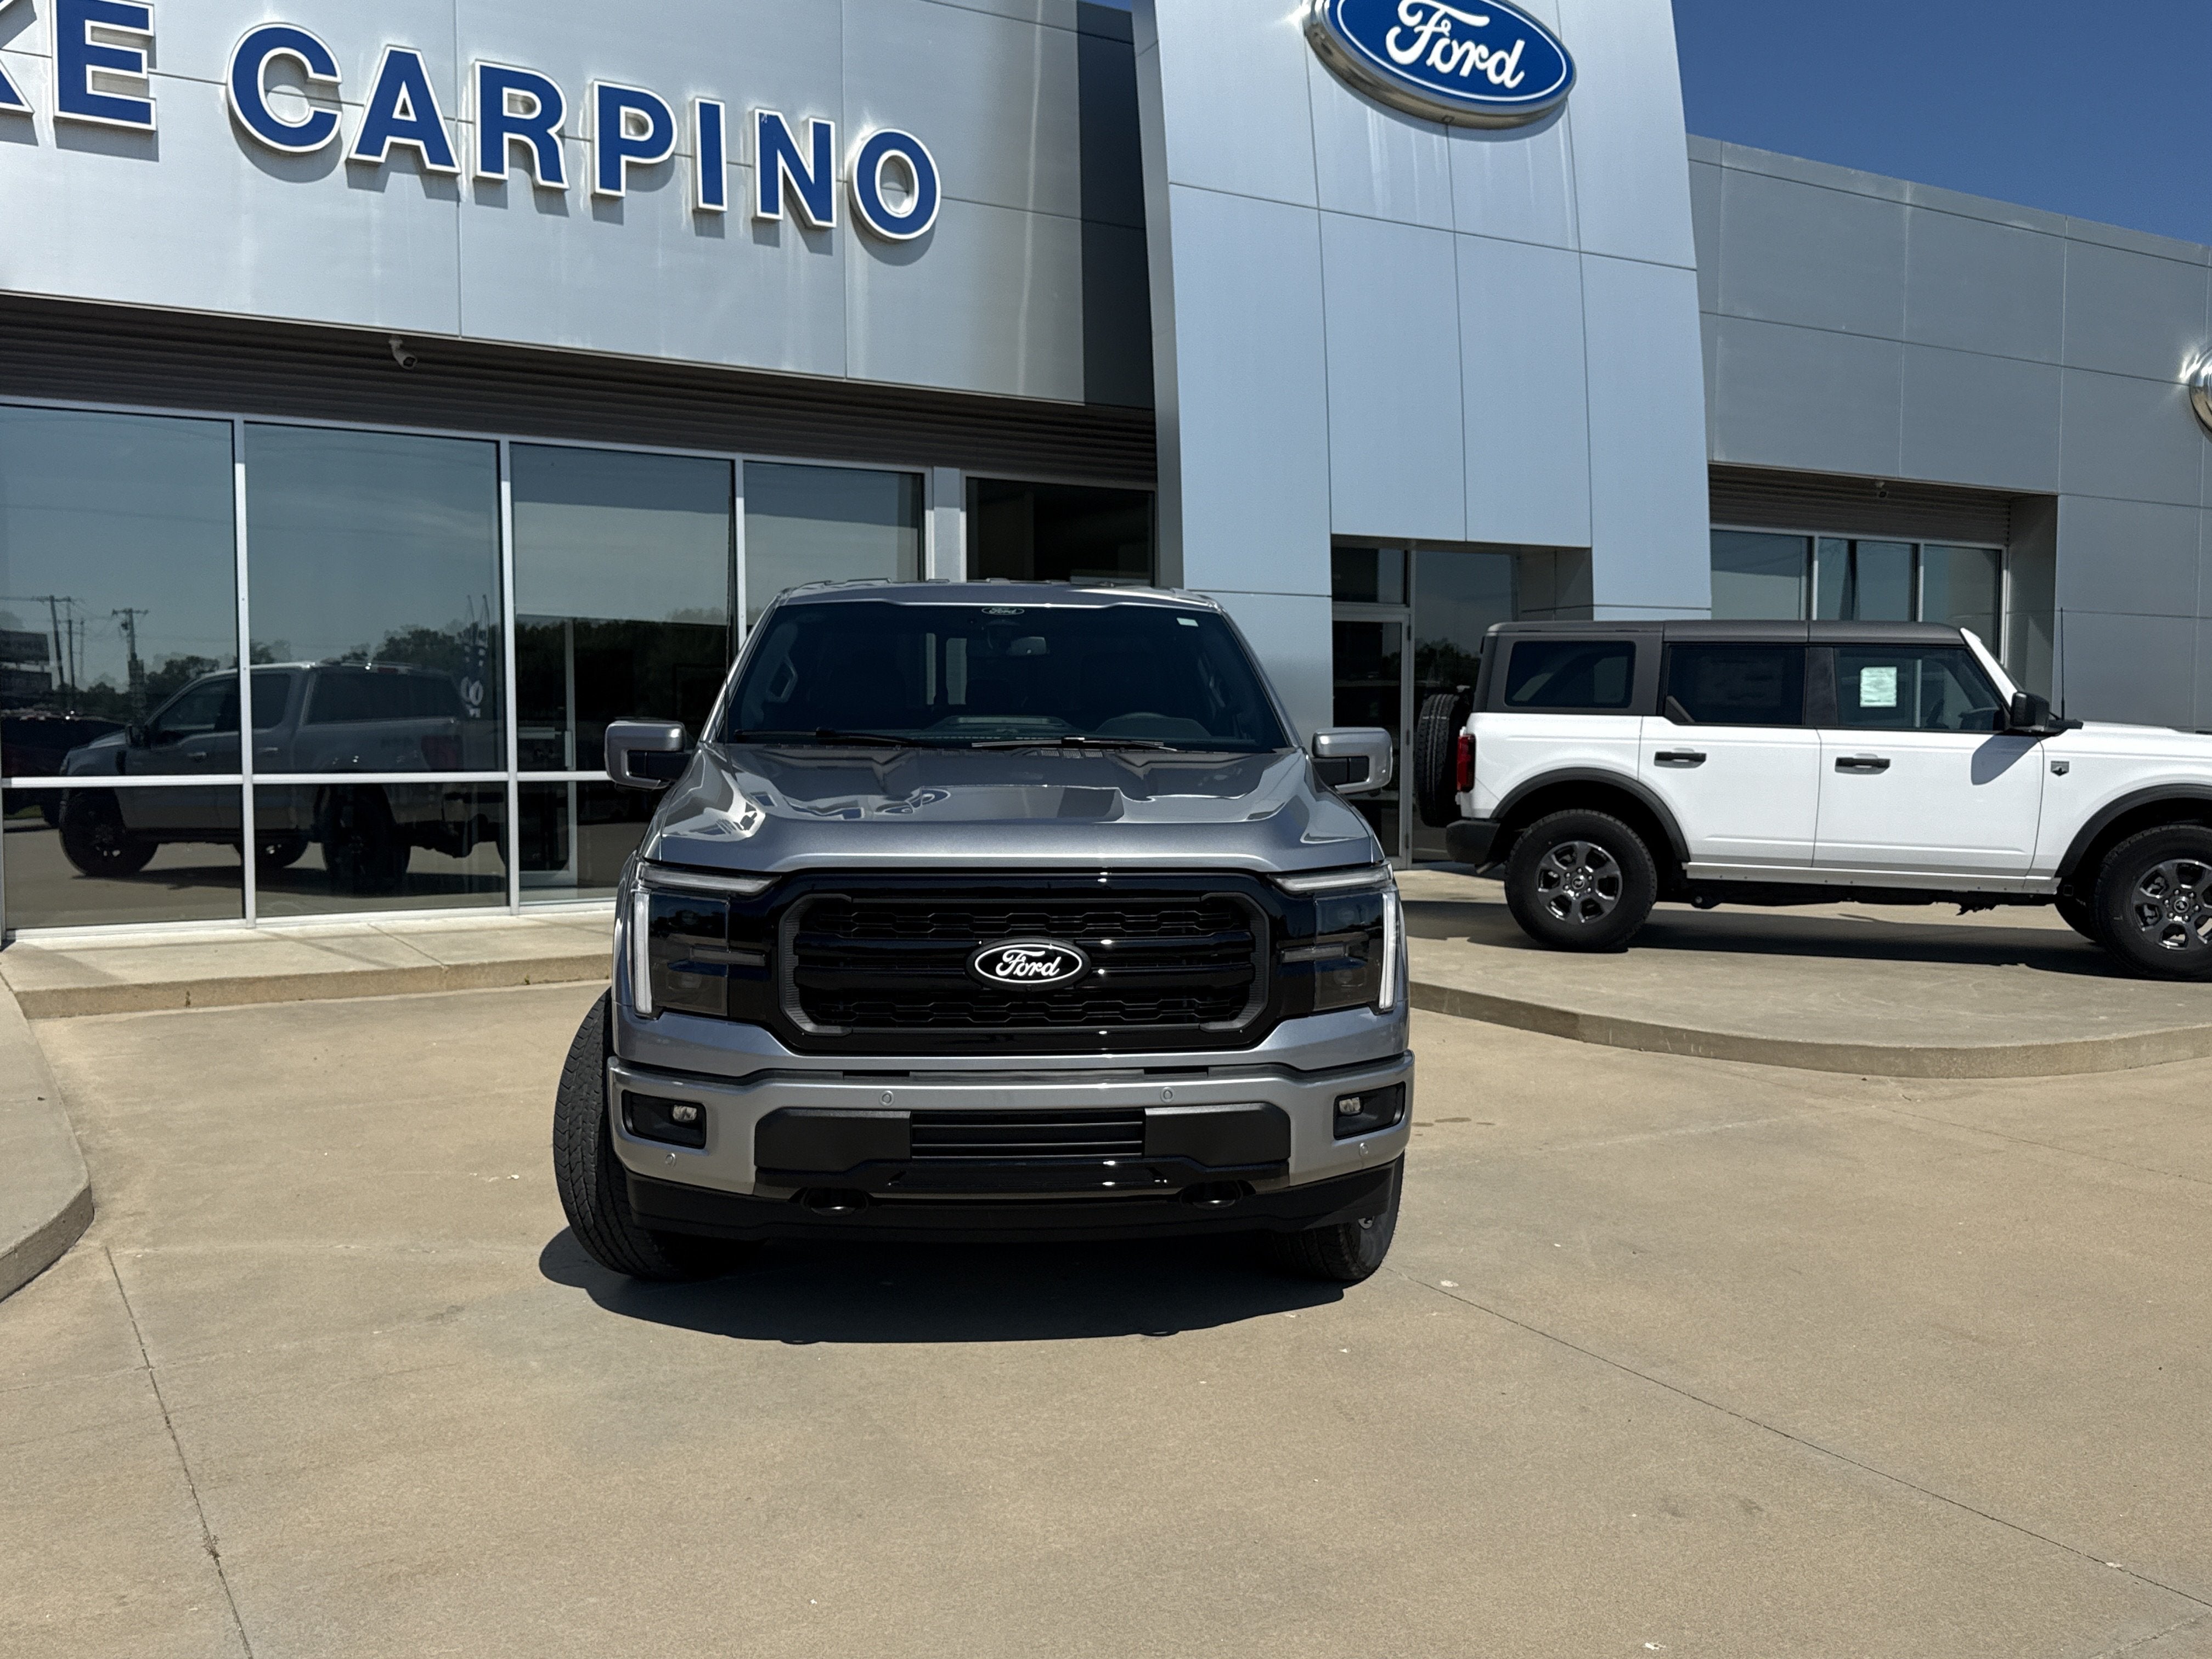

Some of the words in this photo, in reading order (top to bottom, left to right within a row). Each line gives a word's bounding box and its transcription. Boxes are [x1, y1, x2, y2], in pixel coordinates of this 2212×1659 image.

[1385, 0, 1525, 89] Ford
[226, 22, 941, 240] CARPINO
[995, 949, 1062, 977] Ford
